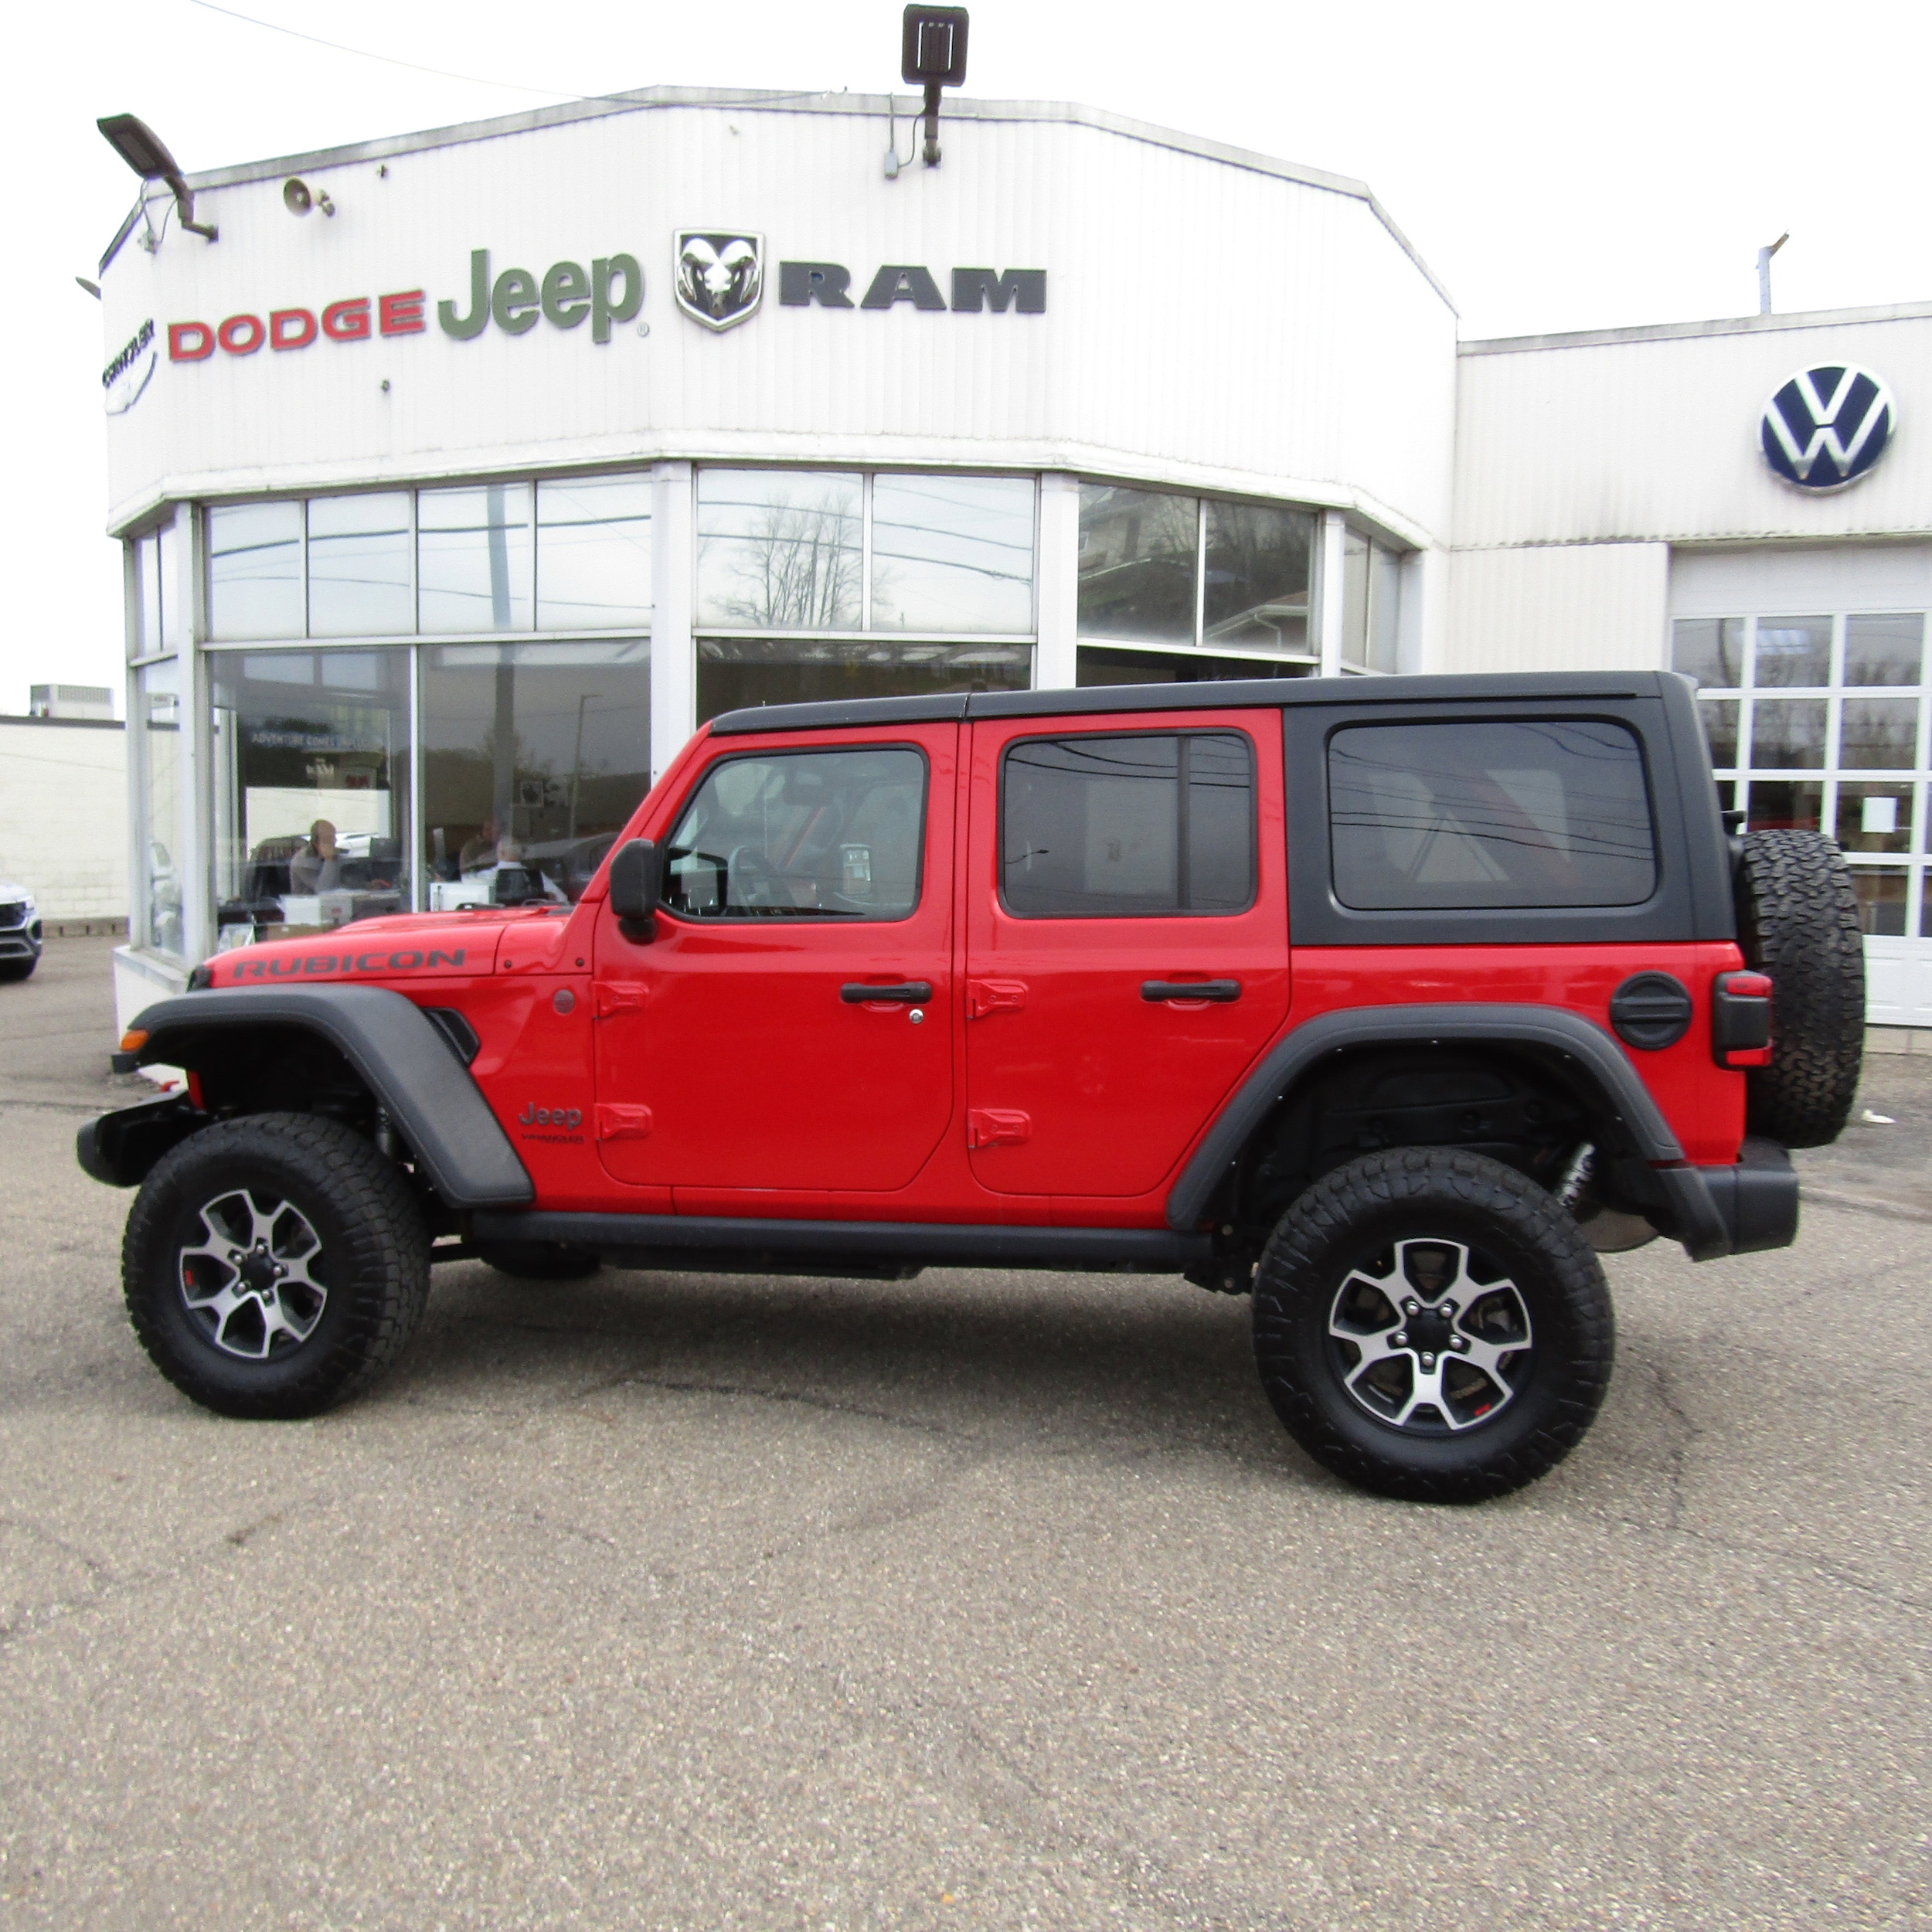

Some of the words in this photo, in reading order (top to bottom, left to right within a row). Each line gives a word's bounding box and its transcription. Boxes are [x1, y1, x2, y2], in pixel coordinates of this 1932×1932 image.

[437, 248, 645, 345] Jeep
[779, 260, 1047, 313] RAM
[167, 289, 426, 362] DODGE
[233, 948, 465, 979] RUBICON
[518, 1101, 582, 1131] Jeep
